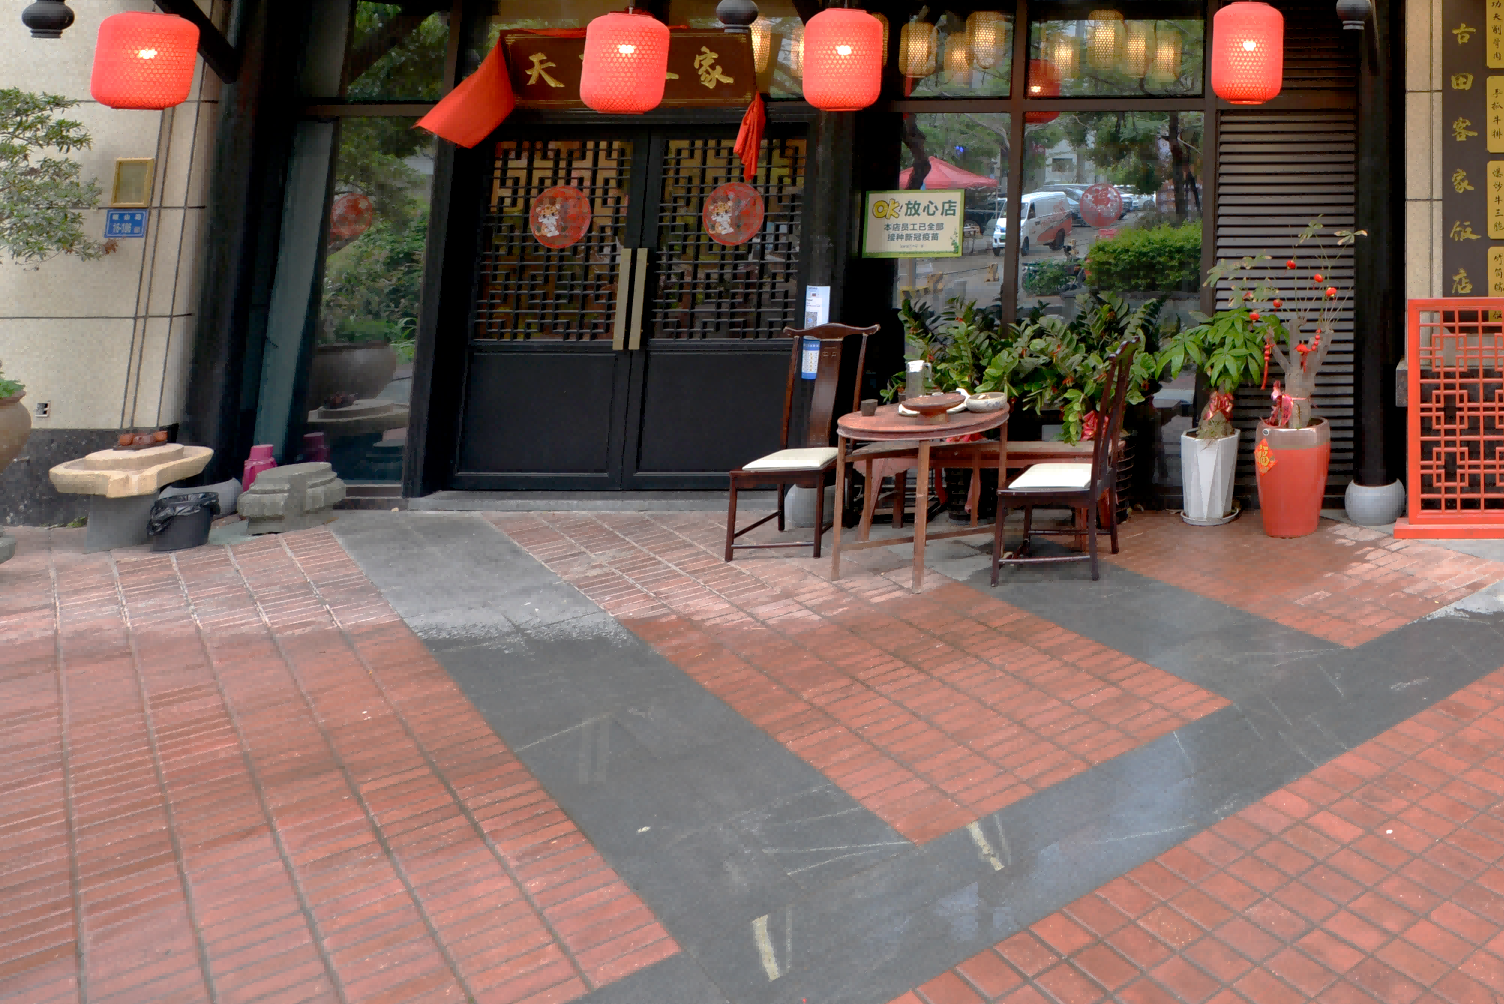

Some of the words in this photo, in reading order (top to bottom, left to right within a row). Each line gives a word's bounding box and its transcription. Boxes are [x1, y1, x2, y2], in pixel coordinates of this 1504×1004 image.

[525, 47, 734, 89] 天家
[1450, 23, 1482, 295] 古田客家饭店
[905, 199, 957, 217] 放心店
[884, 222, 945, 232] 本店员工已全部
[887, 232, 940, 242] 接种新冠疫苗
